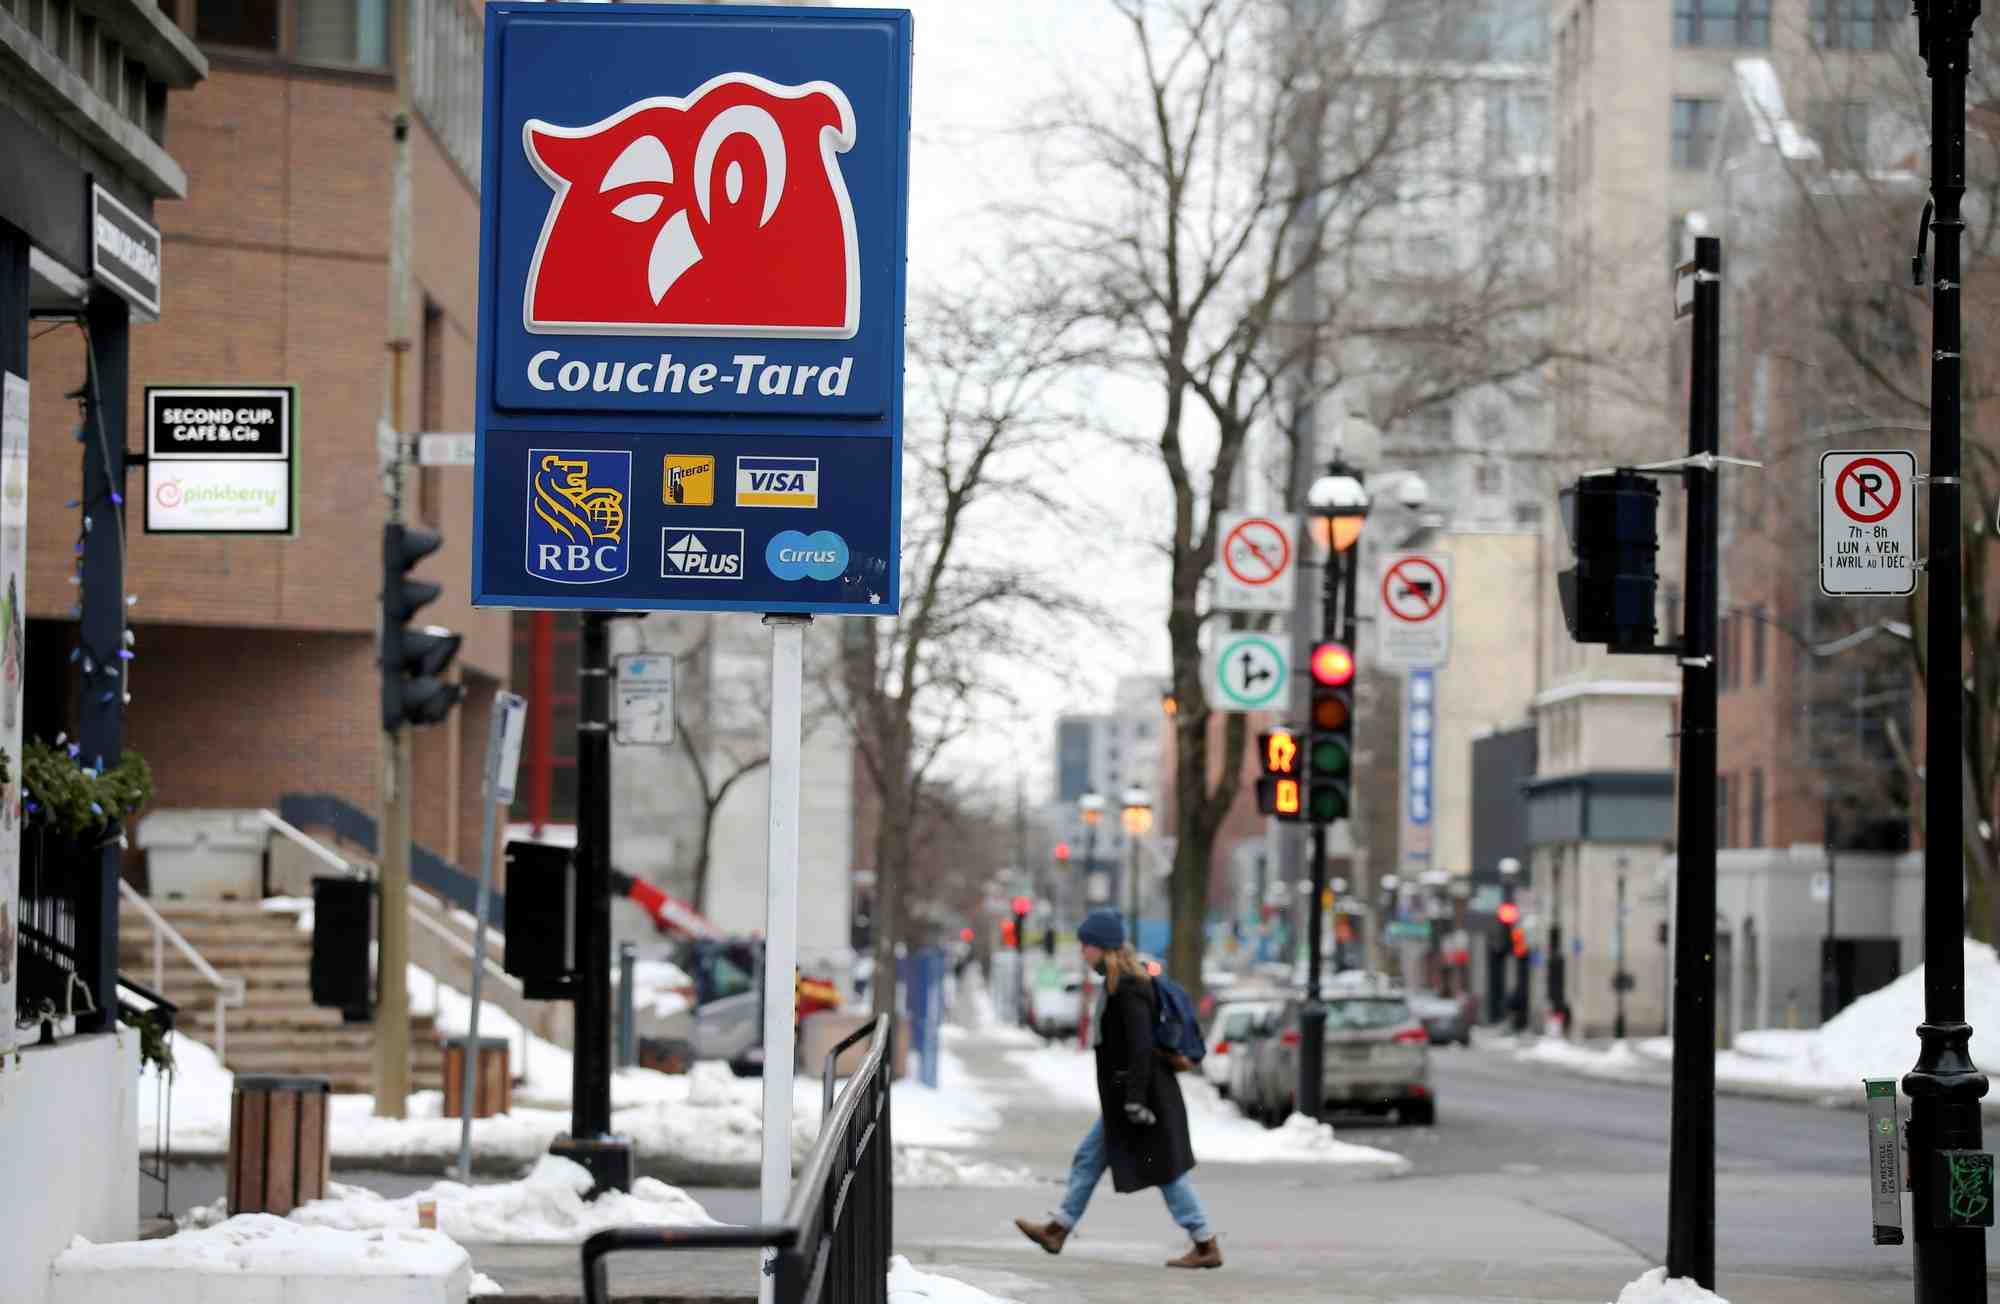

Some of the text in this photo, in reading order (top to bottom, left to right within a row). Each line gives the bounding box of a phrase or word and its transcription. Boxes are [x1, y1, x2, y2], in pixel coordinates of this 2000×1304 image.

[527, 350, 853, 397] Couche-Tard
[162, 408, 234, 424] SECOND
[750, 472, 805, 492] VISA
[1848, 525, 1862, 538] 7h
[1873, 525, 1888, 538] 8h
[1837, 541, 1859, 554] LUN
[1876, 541, 1900, 554] VEN
[538, 544, 618, 572] RBC
[685, 553, 739, 573] PLUS
[779, 548, 836, 564] Cirrus
[1836, 556, 1863, 569] AVRIL
[1867, 560, 1877, 569] AU
